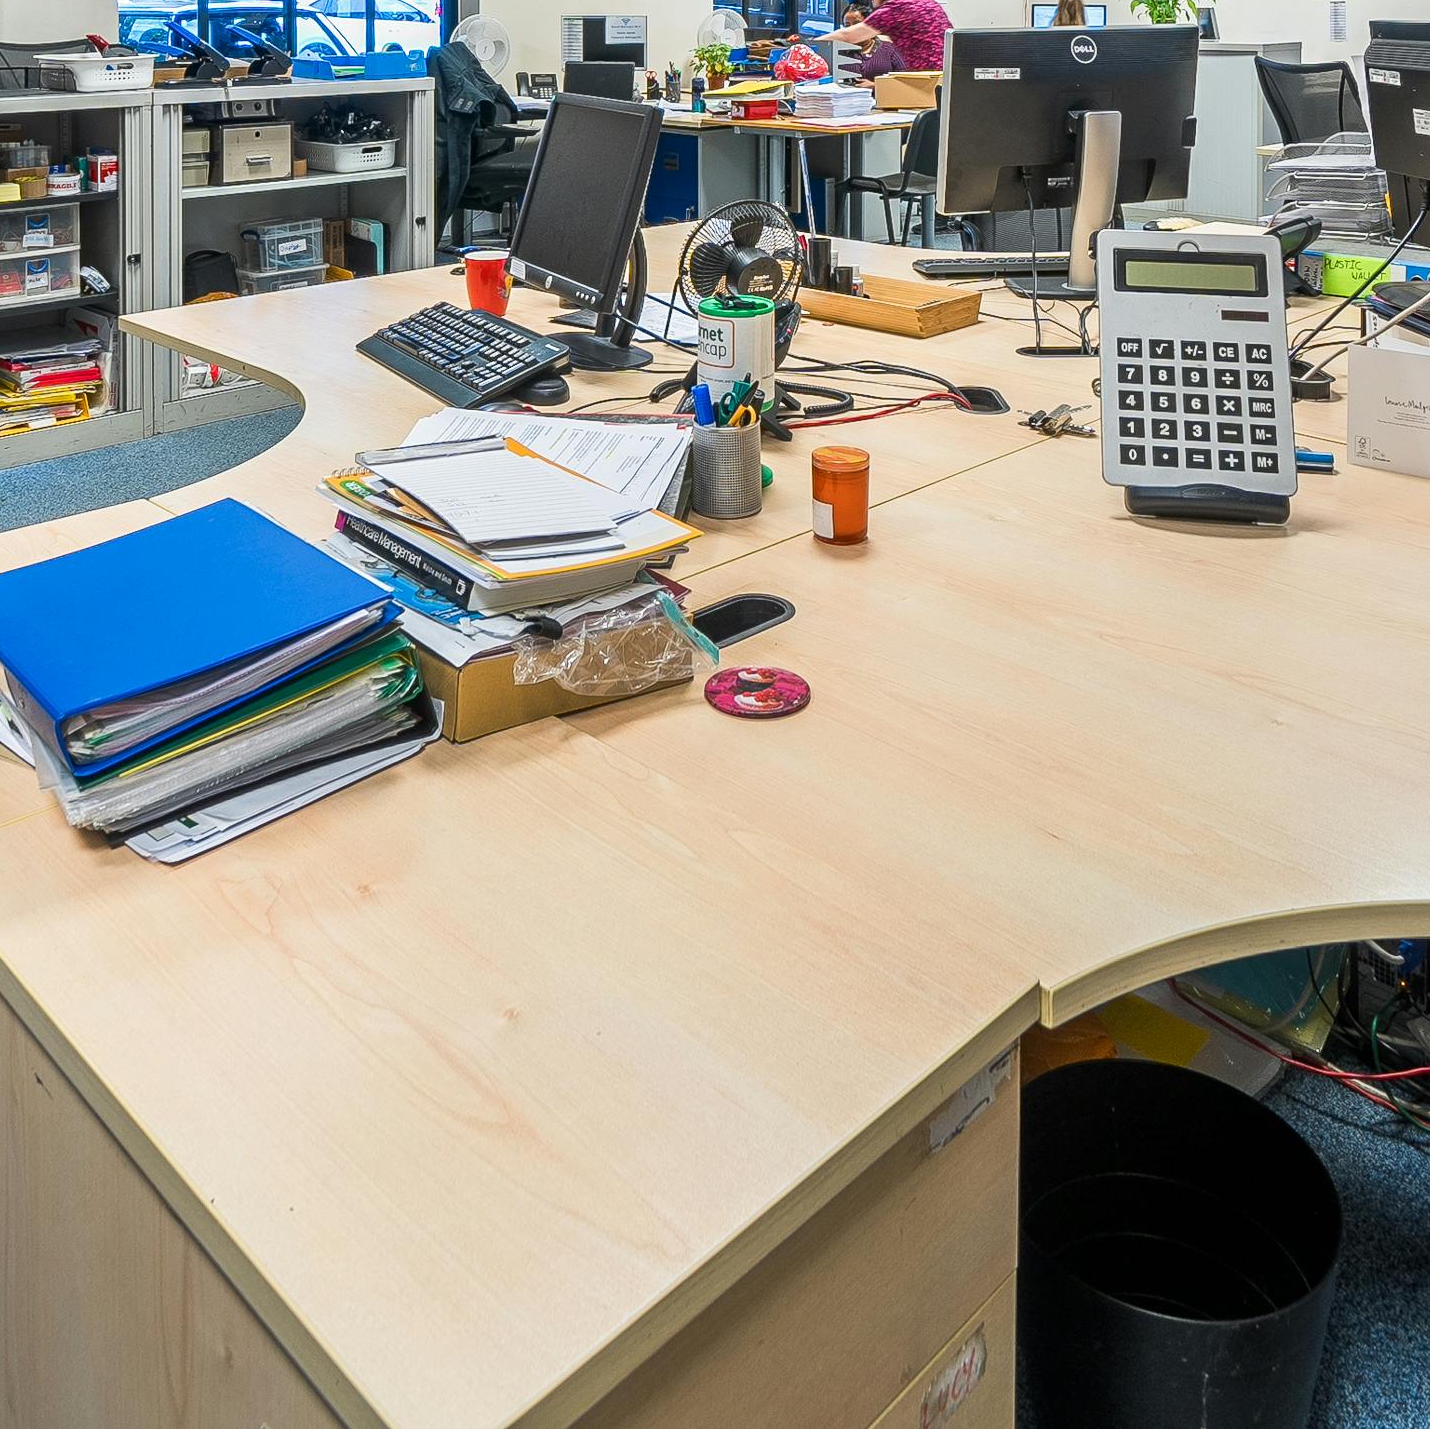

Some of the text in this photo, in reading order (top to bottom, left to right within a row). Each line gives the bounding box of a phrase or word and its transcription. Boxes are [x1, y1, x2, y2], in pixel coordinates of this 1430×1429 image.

[1073, 45, 1095, 53] DELL
[1324, 258, 1363, 271] PLASTIC
[1351, 271, 1387, 281] WALLT
[1121, 343, 1139, 352] OFF
[1219, 347, 1234, 357] CE
[1252, 348, 1268, 359] AC
[1126, 368, 1135, 380] 7
[1158, 370, 1168, 381] 8
[1190, 371, 1200, 383] 9
[1126, 395, 1272, 413] 4 5 6 MRC
[1127, 421, 1272, 440] 1 2 3 M-
[1128, 449, 1137, 461] 0
[1257, 456, 1273, 468] M+
[346, 516, 379, 544] Healthcare
[379, 530, 422, 568] Management
